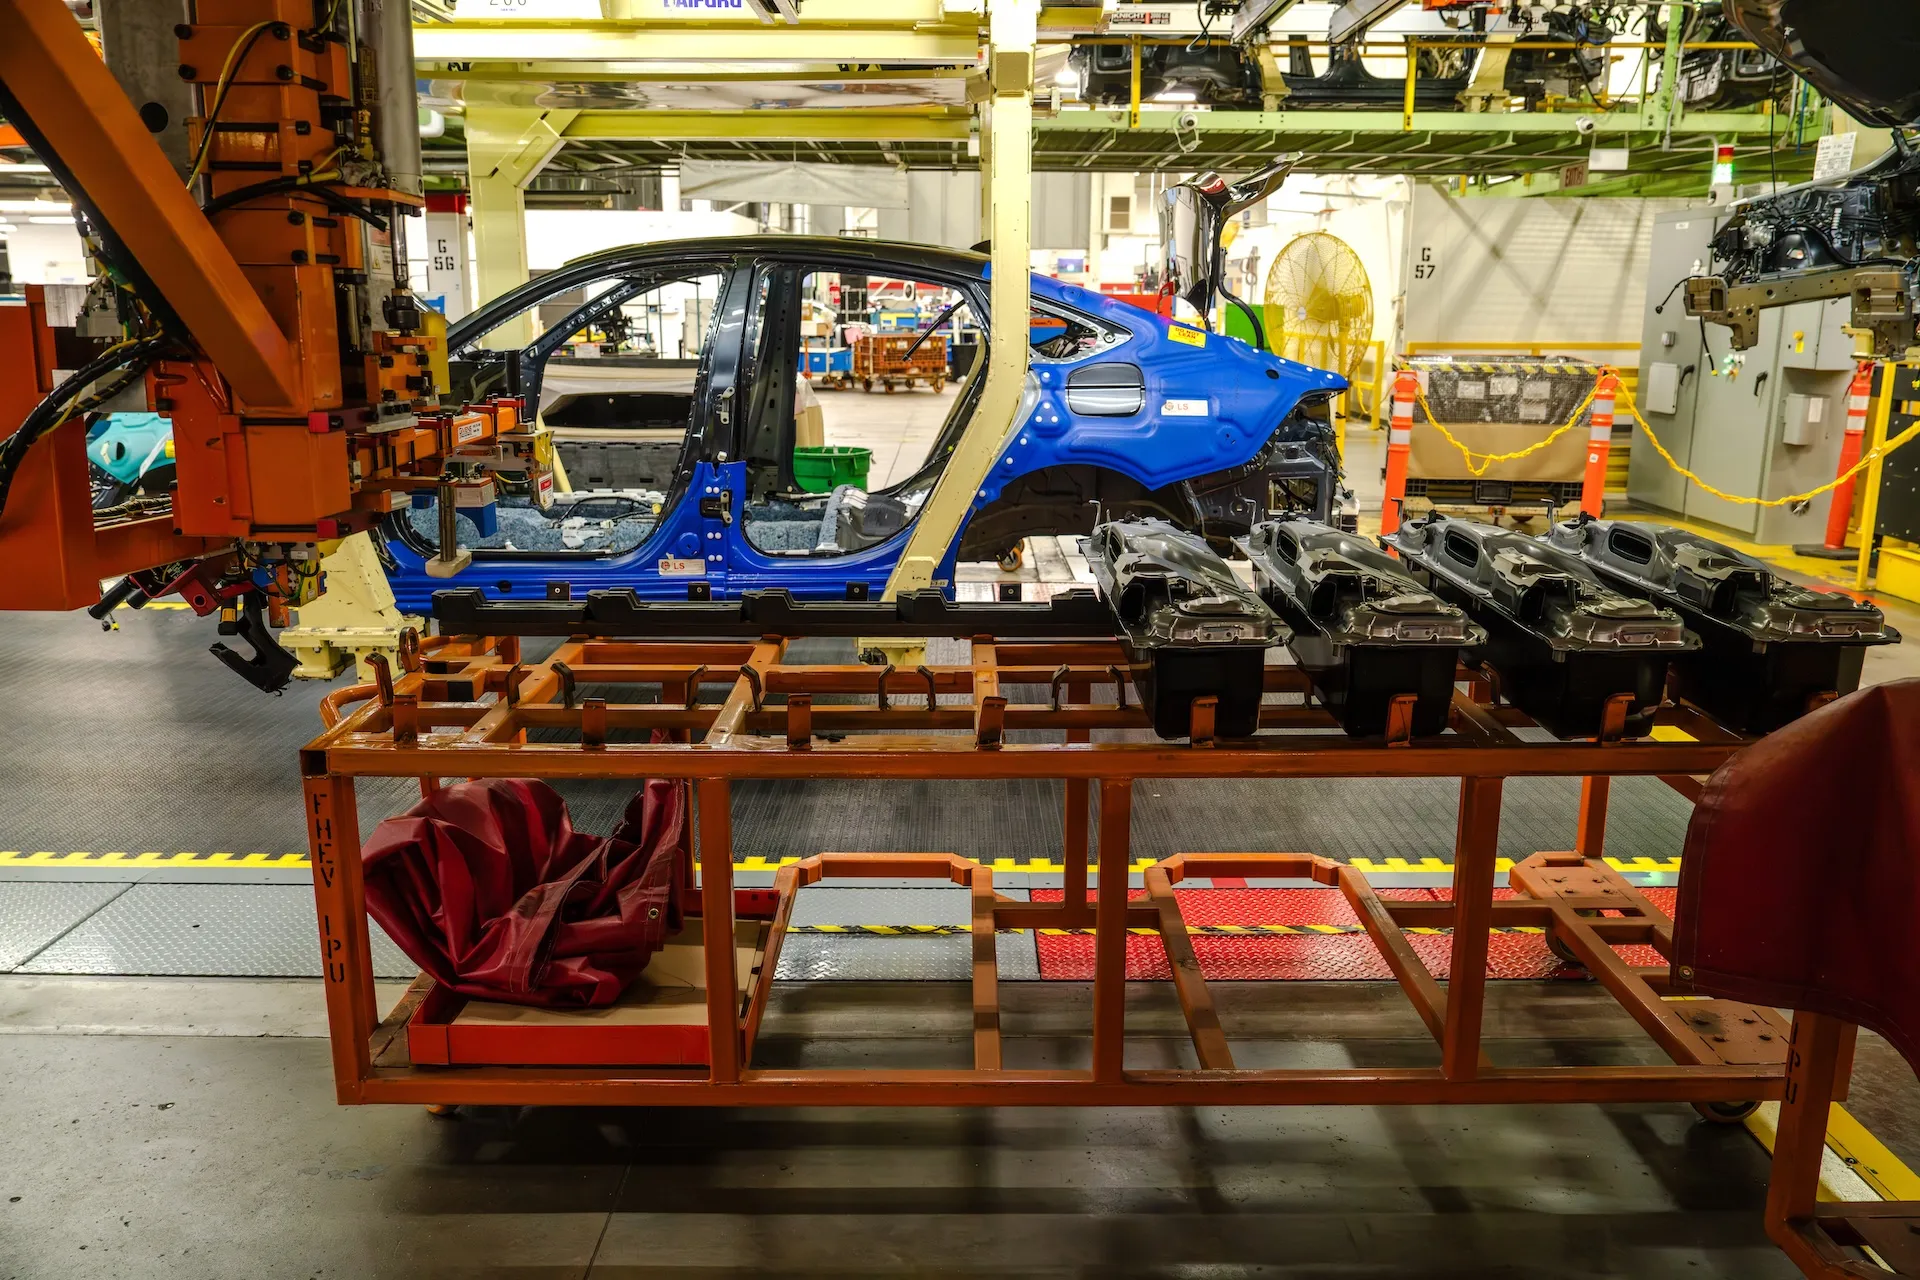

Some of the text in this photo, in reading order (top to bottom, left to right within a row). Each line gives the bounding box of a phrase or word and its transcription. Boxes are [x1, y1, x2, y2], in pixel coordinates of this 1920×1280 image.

[437, 239, 447, 253] G
[1422, 247, 1431, 261] G
[1415, 264, 1436, 279] 57
[1178, 331, 1196, 340] LEAN
[1177, 403, 1189, 411] LS
[673, 562, 685, 570] LS
